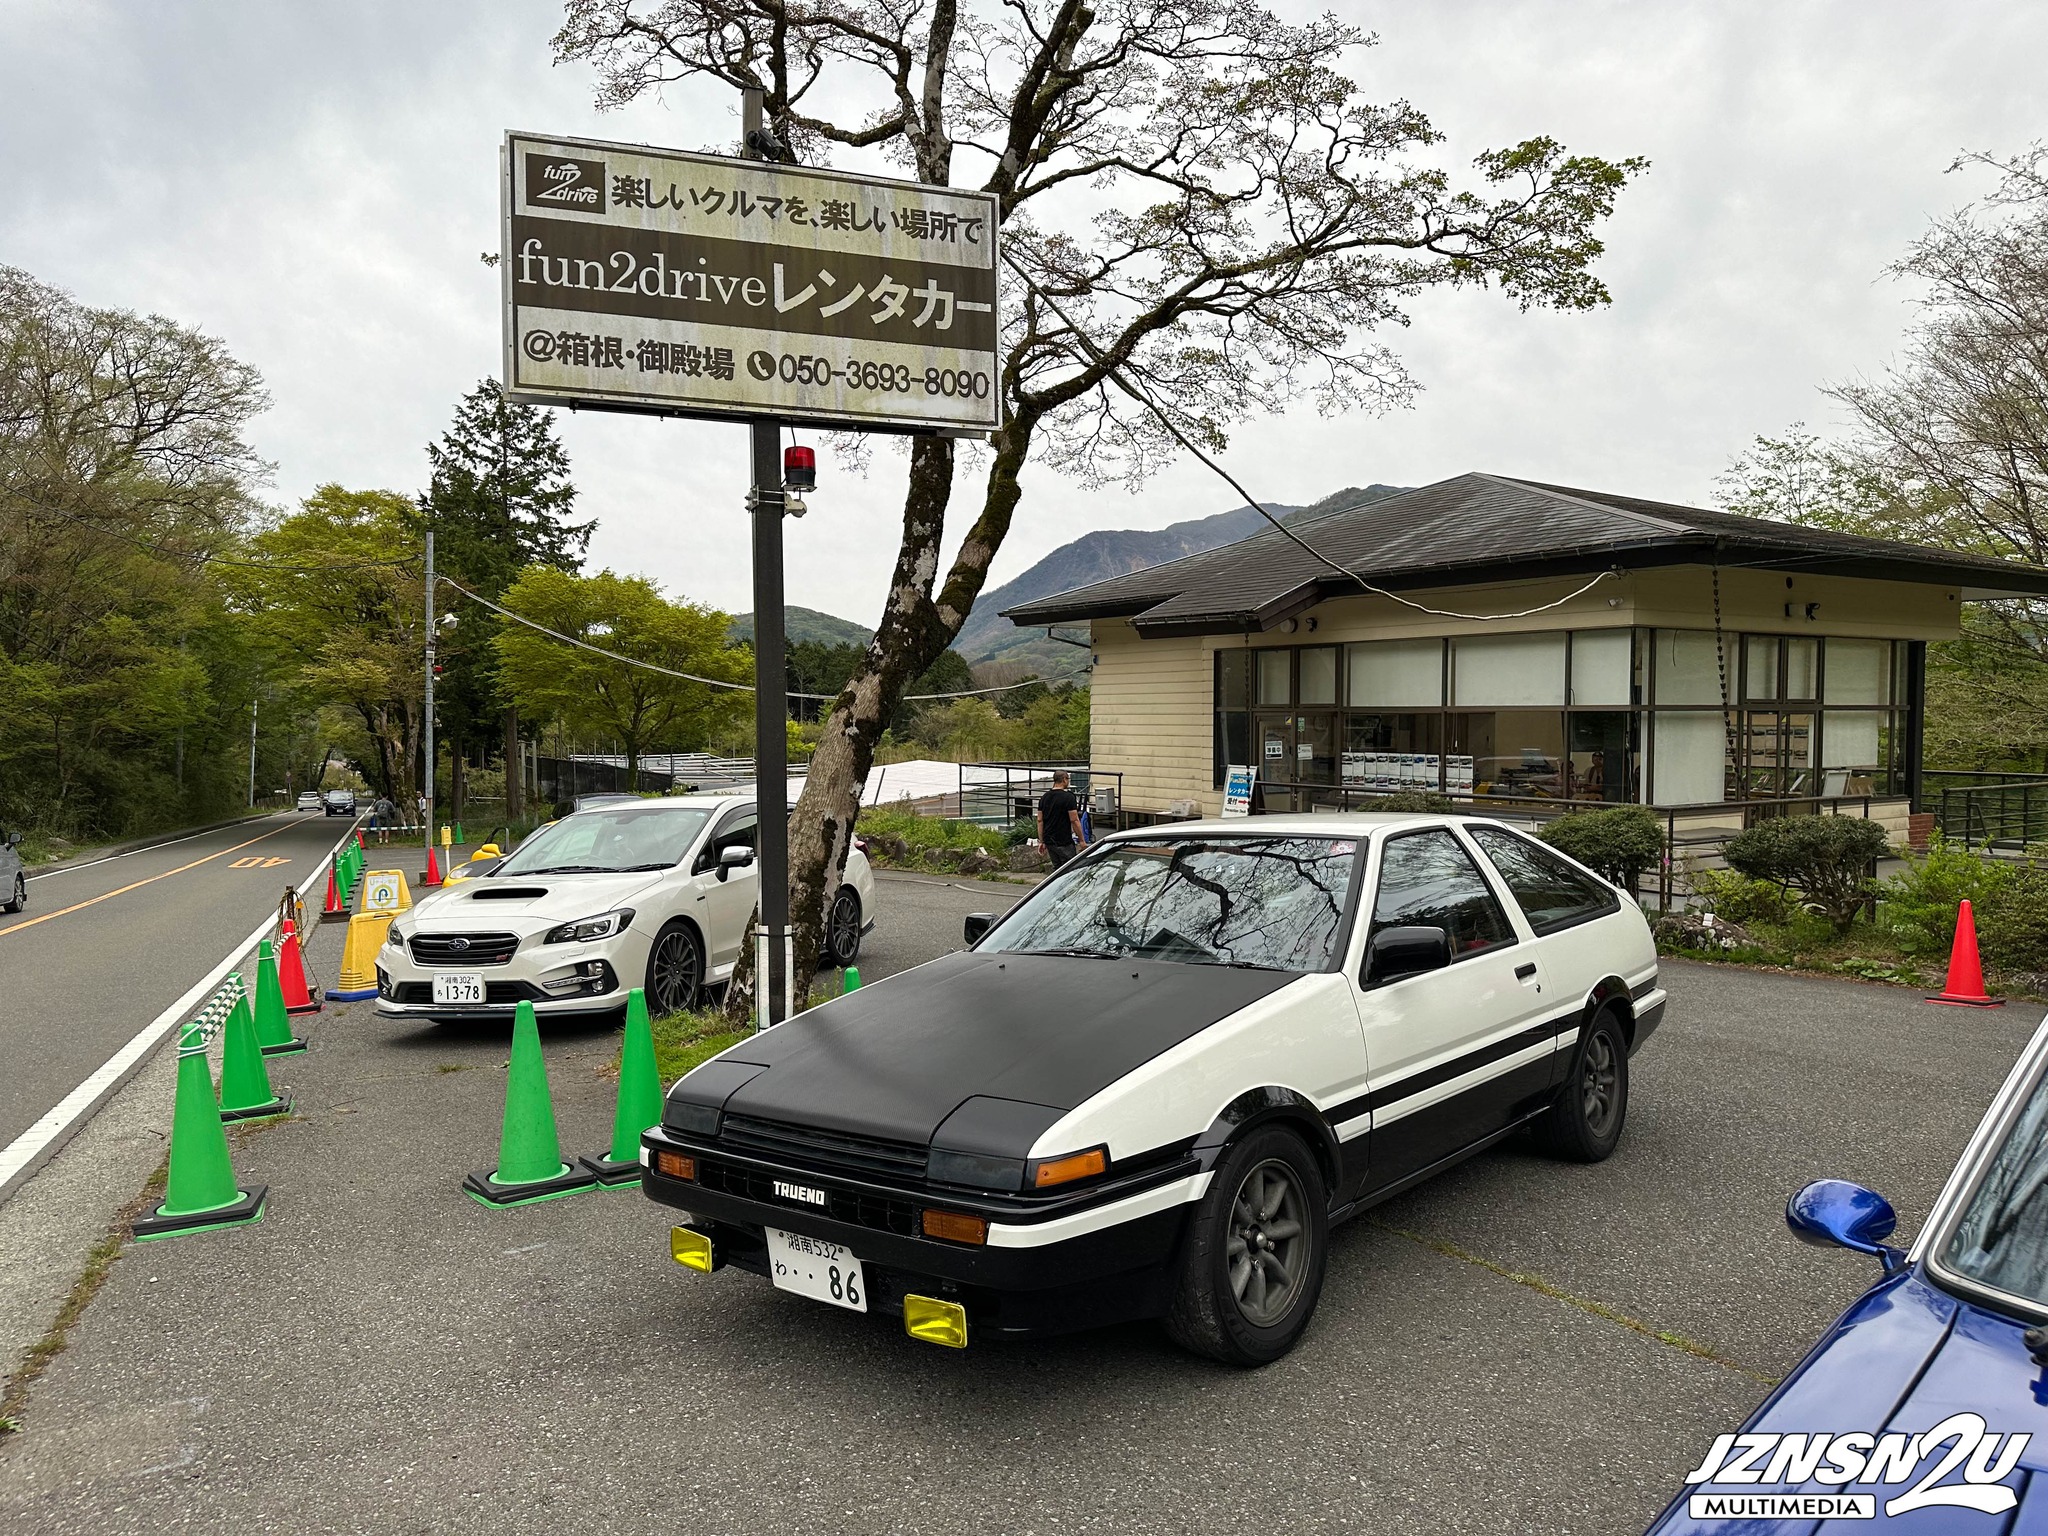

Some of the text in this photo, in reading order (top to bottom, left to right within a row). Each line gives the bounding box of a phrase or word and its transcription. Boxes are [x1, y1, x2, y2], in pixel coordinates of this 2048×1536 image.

[543, 164, 574, 181] fun
[556, 187, 598, 204] drive
[612, 175, 984, 244] 楽しいクルマを、楽しい場所で
[778, 354, 990, 400] 050-3693-8090
[446, 985, 480, 1000] 13-78
[773, 1181, 826, 1206] TRUENO
[828, 1265, 860, 1305] 86
